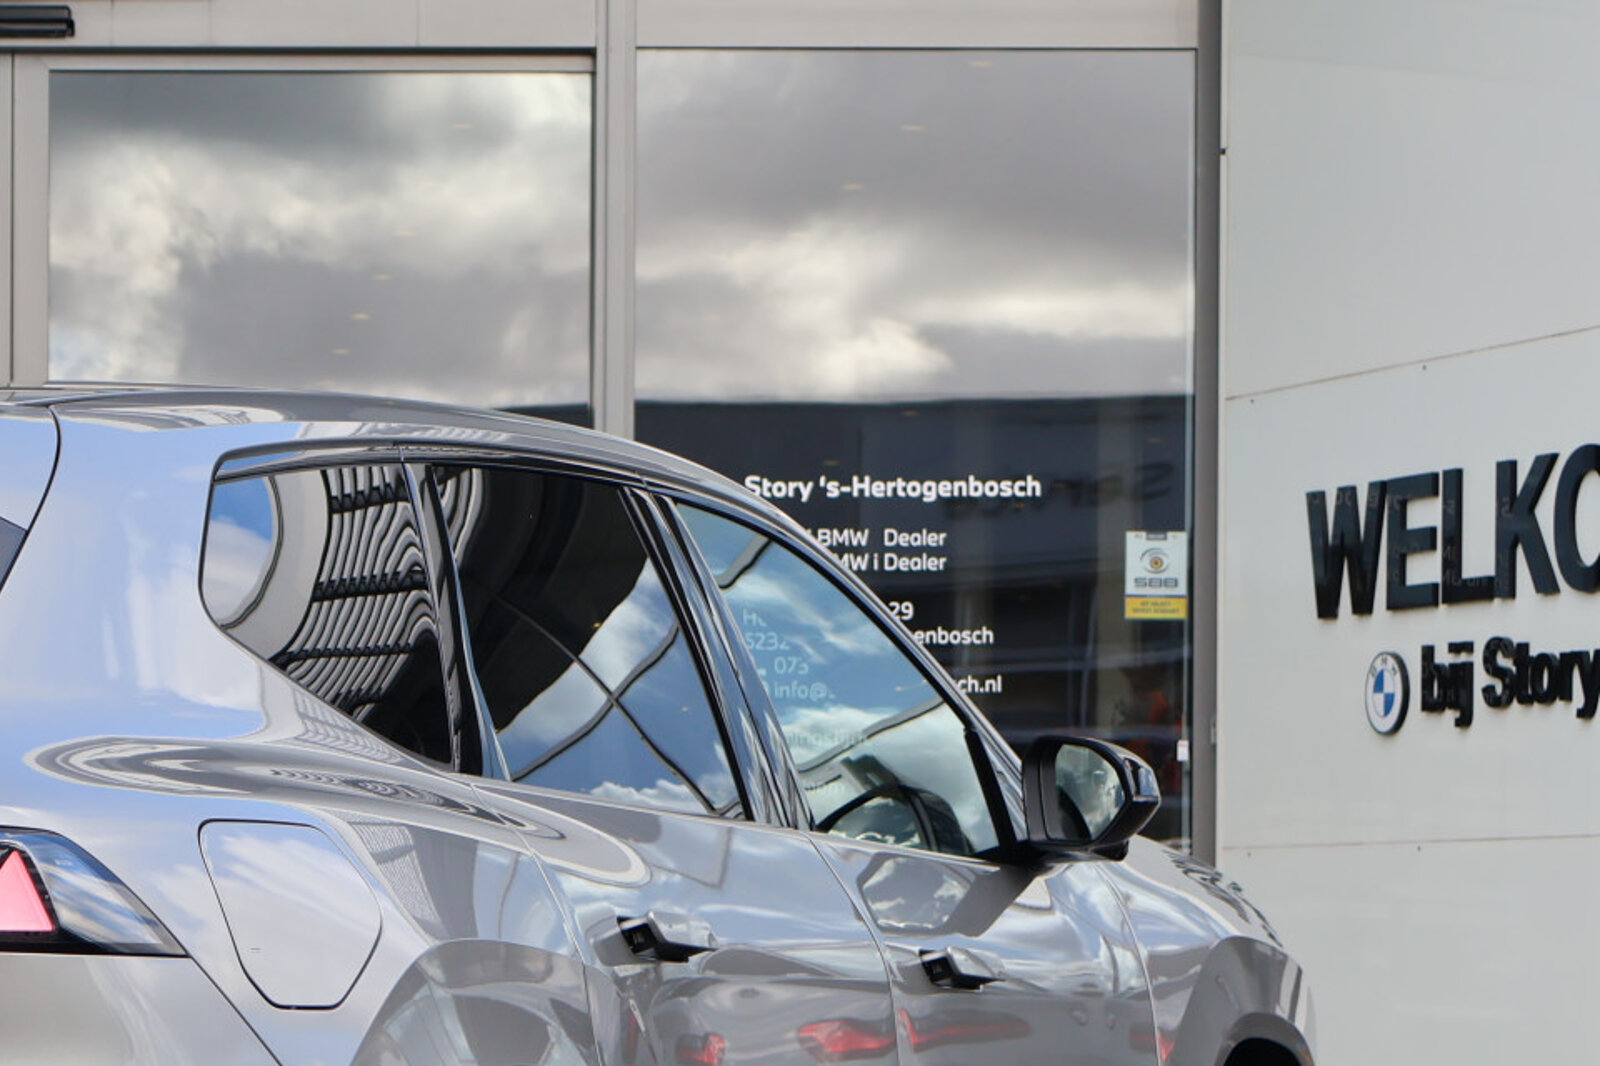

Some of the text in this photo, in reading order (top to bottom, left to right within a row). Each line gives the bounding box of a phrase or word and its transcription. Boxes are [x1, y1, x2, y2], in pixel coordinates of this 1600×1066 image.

[744, 474, 814, 503] Story
[819, 474, 1042, 502] ‘s-Hertogenbosch
[817, 528, 947, 547] BMW Dealer
[1306, 443, 1600, 619] WELKO
[873, 552, 879, 571] i
[884, 552, 947, 571] Dealer
[888, 601, 914, 620] 29
[913, 626, 994, 645] enbosch
[774, 680, 836, 701] info@
[1421, 640, 1474, 727] bij
[1481, 635, 1600, 720] Story
